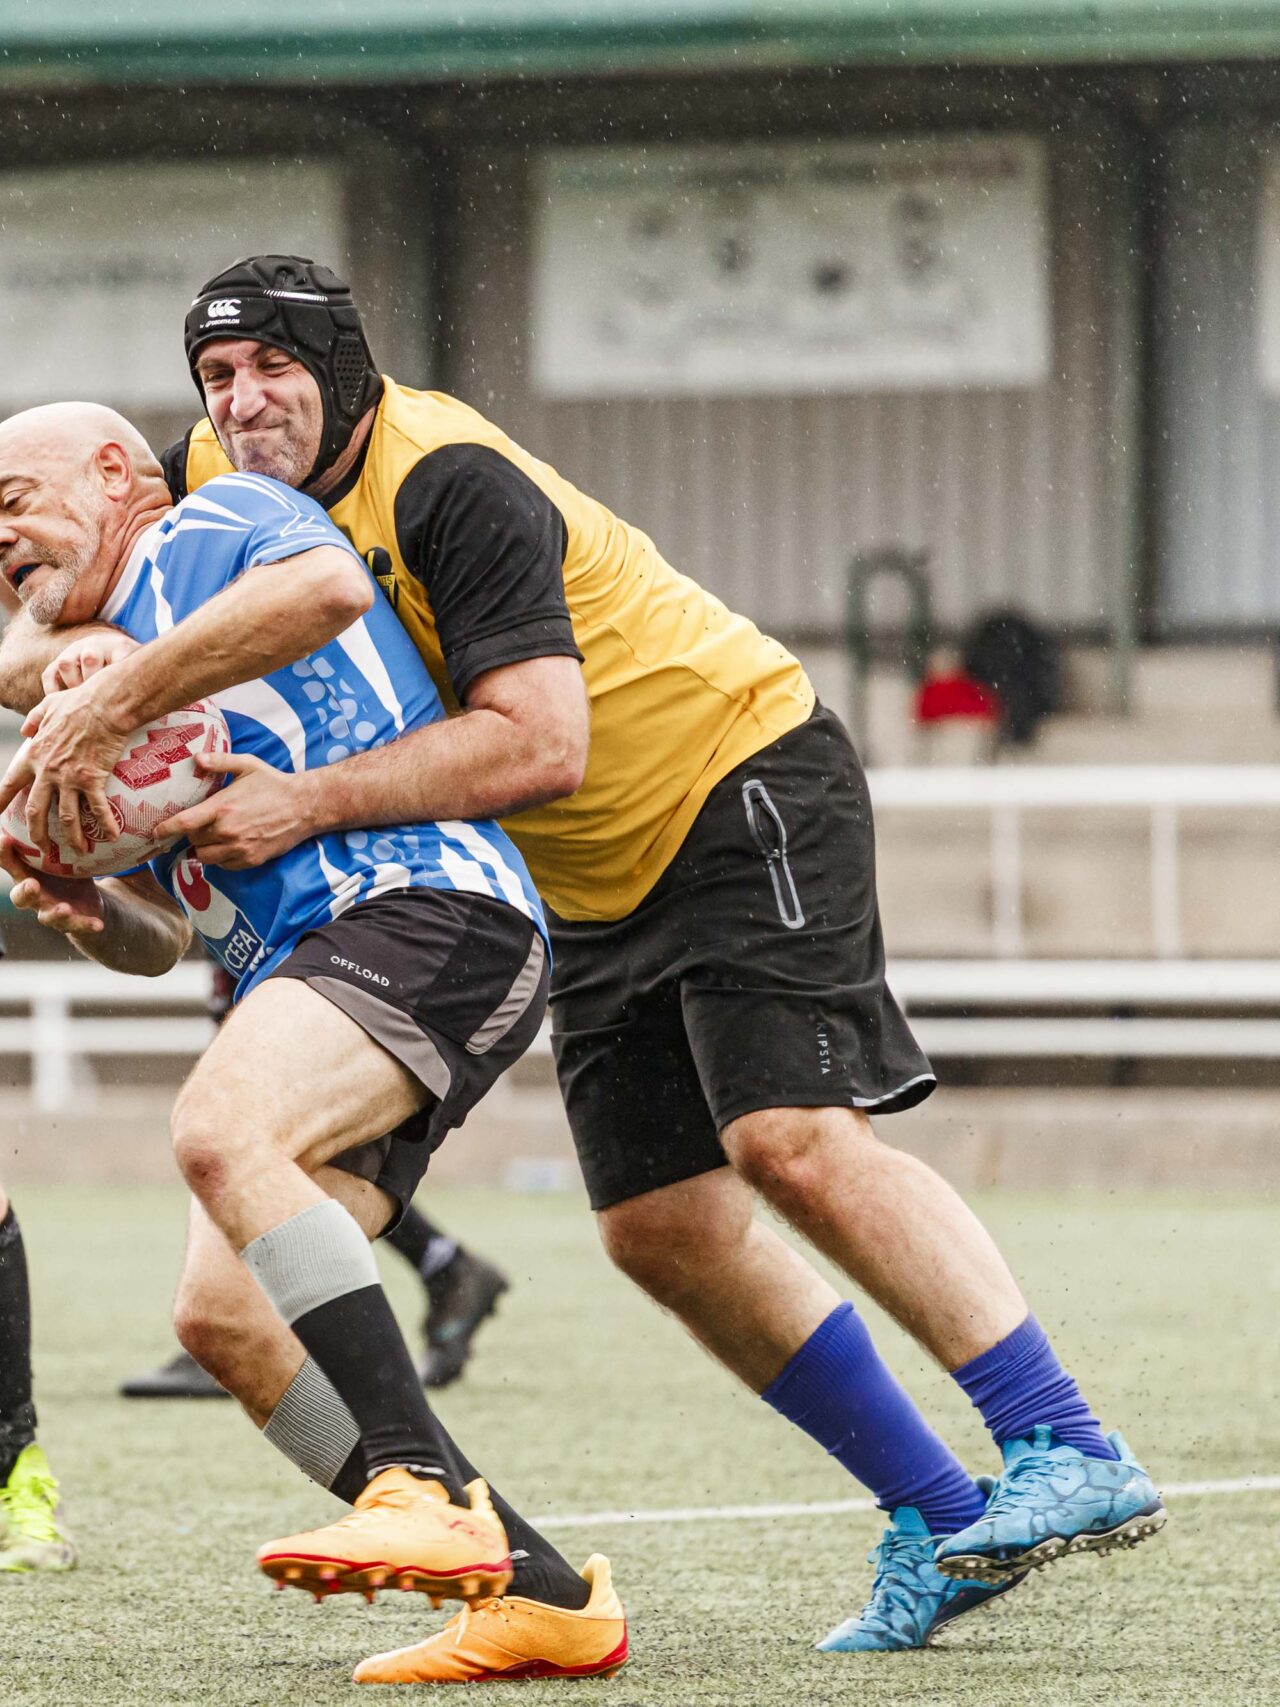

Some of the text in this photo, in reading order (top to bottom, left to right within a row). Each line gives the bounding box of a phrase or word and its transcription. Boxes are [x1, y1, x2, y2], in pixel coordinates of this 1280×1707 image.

[224, 929, 257, 969] CEFA
[330, 955, 390, 988] OFFLOAD
[817, 1022, 830, 1074] KIPSTA
